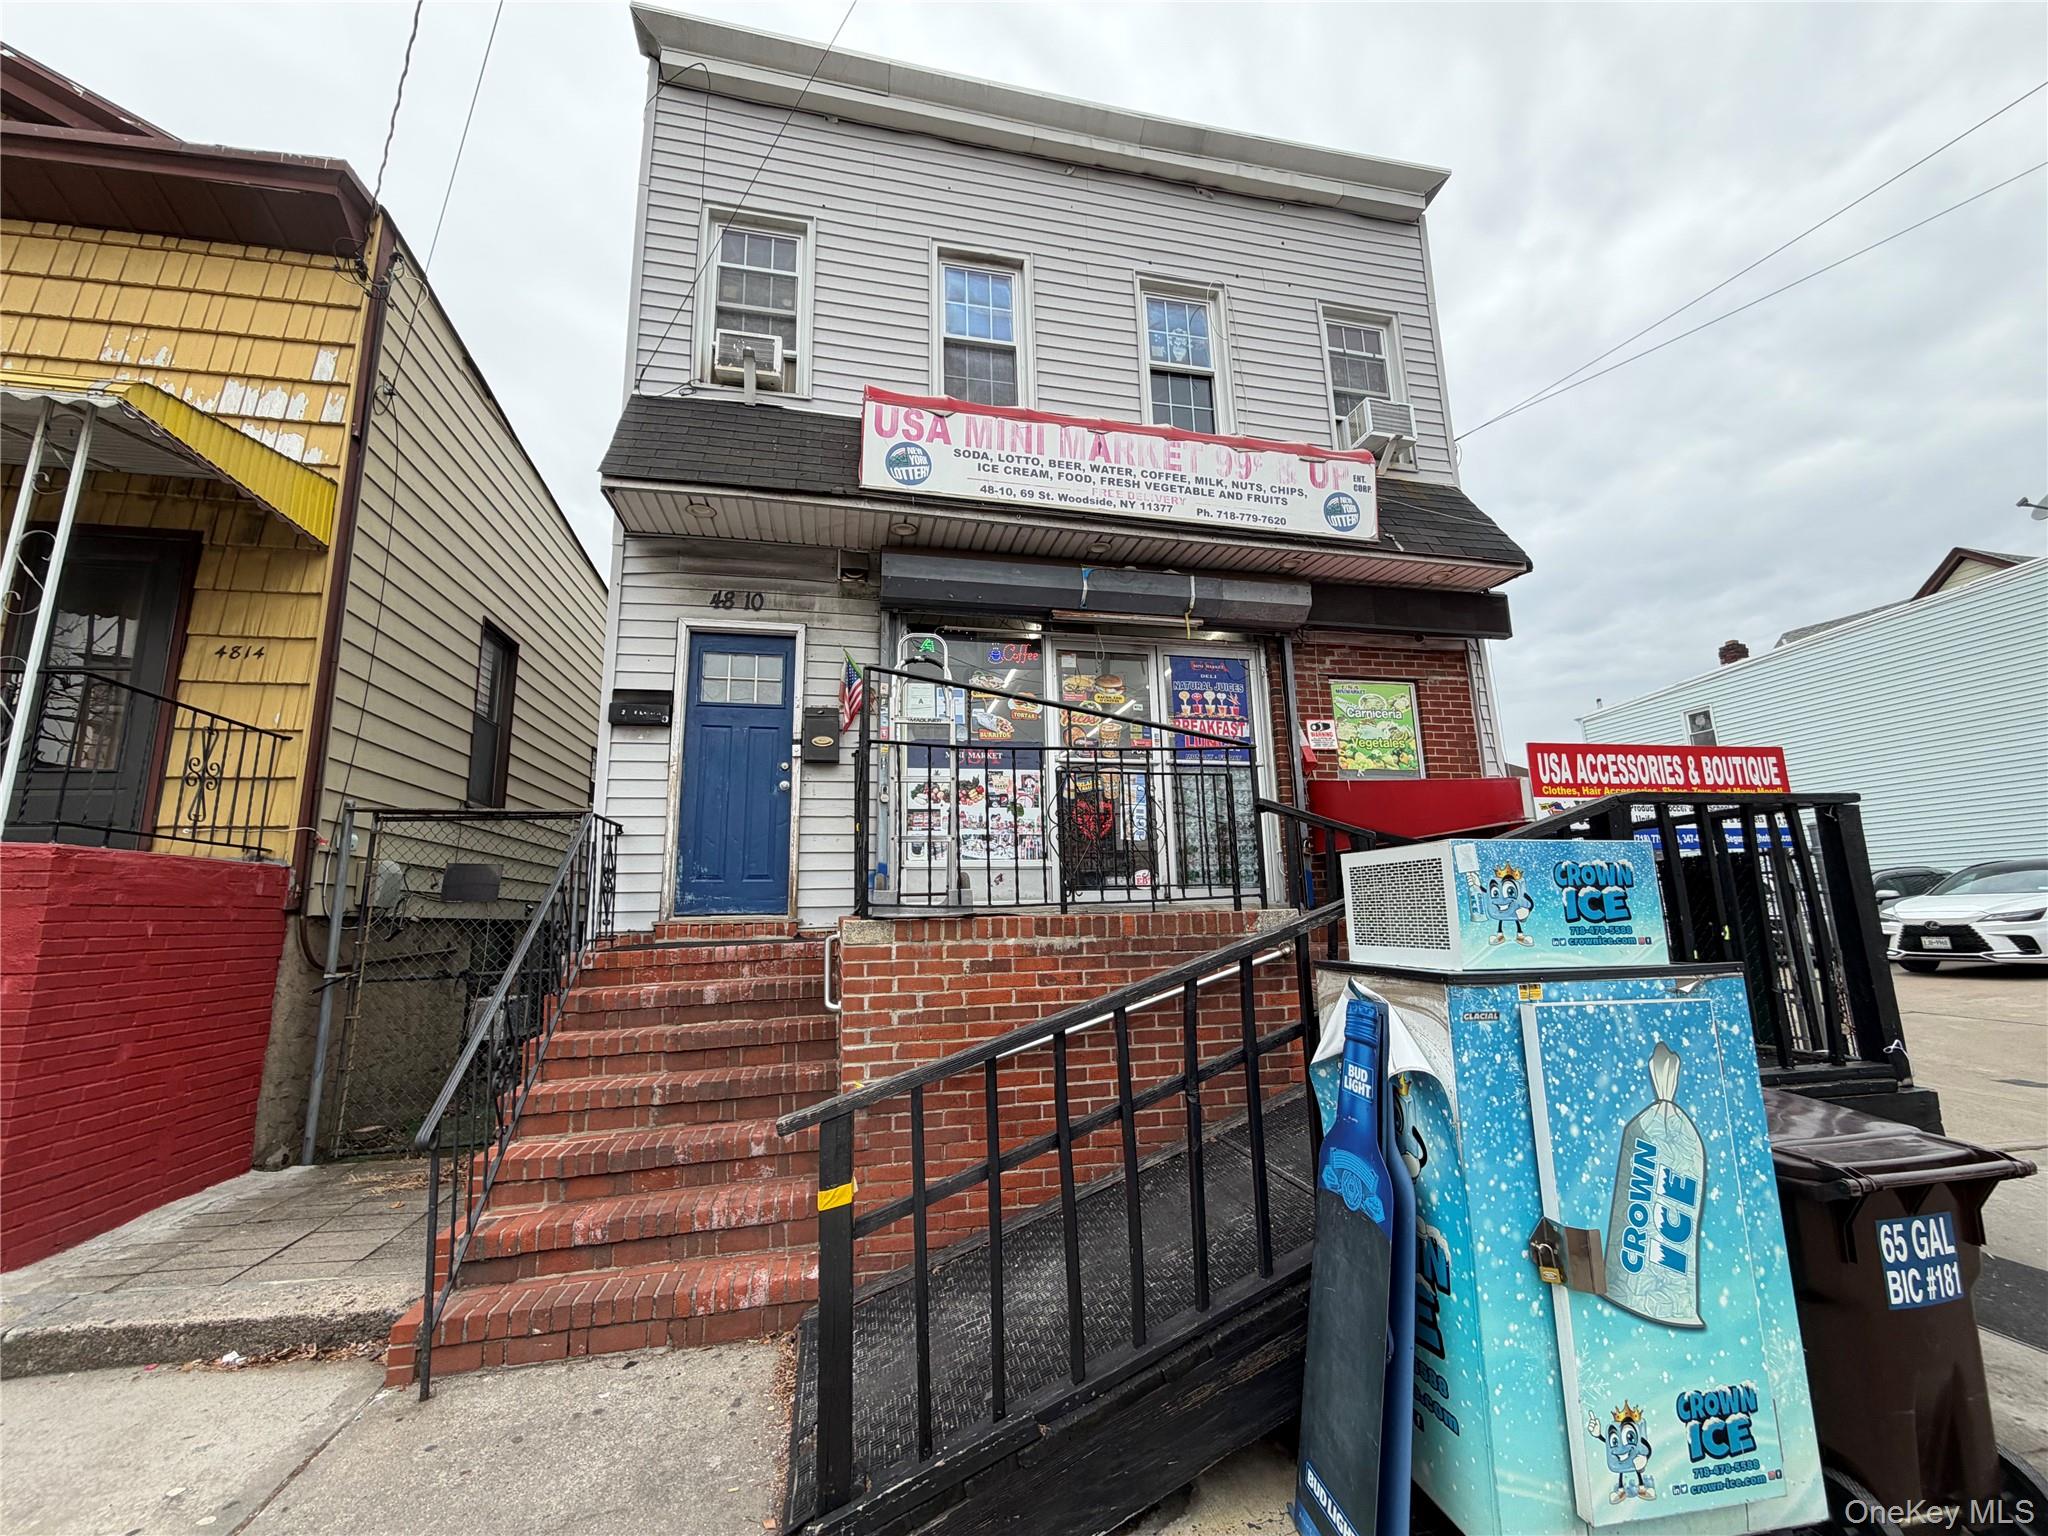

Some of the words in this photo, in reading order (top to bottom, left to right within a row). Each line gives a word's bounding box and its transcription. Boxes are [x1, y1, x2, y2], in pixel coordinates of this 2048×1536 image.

[874, 404, 952, 445] USA
[964, 415, 1045, 456] MINI
[1059, 426, 1203, 473] MARKET
[906, 446, 923, 456] NEW
[909, 455, 928, 466] YORK
[889, 466, 930, 481] LOTTERY
[953, 448, 993, 463] SODA,
[998, 453, 1044, 469] LOTTO,
[1048, 459, 1086, 473] BEER,
[1090, 463, 1137, 478] WATER,
[1140, 469, 1191, 485] COFFEE,
[1194, 475, 1228, 490] MILK,
[1231, 480, 1266, 494] NUTS,
[1270, 485, 1308, 499] CHIPS,
[977, 462, 999, 474] ICE
[1003, 466, 1054, 482] CREAM,
[1058, 471, 1096, 486] FOOD,
[1100, 476, 1140, 489] FRESH
[1144, 481, 1215, 498] VEGETABLE
[1218, 490, 1243, 501] AND
[1246, 493, 1288, 506] FRUITS
[979, 484, 1017, 499] 48-10,
[1020, 488, 1035, 499] 69
[1038, 491, 1054, 501] St.
[1057, 492, 1117, 509] Woodside,
[1120, 499, 1136, 509] NY
[1139, 501, 1173, 513] 11377
[1353, 484, 1373, 494] CORP.
[1196, 507, 1213, 518] Ph.
[1216, 510, 1287, 526] 718-779-7620
[1328, 513, 1360, 528] LOTTERY
[709, 590, 735, 610] 48
[743, 592, 764, 611] 10
[214, 645, 266, 661] 4814
[1002, 643, 1040, 664] Coffee
[1172, 680, 1214, 691] NATURAL
[1214, 682, 1244, 693] JUICES
[979, 731, 1012, 739] BURRITOS
[1173, 719, 1245, 738] BREAKFAST
[1351, 737, 1406, 750] Vegetales
[1537, 752, 1574, 784] USA
[1576, 753, 1685, 785] ACCESSORIES
[1687, 755, 1700, 786] &
[1700, 755, 1781, 787] BOUTIQUE
[1542, 785, 1580, 797] Clothes,
[1581, 786, 1600, 795] Hair
[1553, 860, 1634, 888] CROWN
[1562, 886, 1632, 923] ICE
[1569, 925, 1633, 935] 718-478-5588
[1463, 1012, 1499, 1020] GLACIAL
[1348, 1063, 1368, 1083] BUD
[1344, 1075, 1373, 1099] LIGHT
[1620, 1137, 1657, 1275] CROWN
[1648, 1163, 1698, 1276] ICE
[1879, 1222, 1908, 1264] 65
[1911, 1216, 1956, 1261] GAL
[1886, 1267, 1924, 1305] BIC
[1926, 1261, 1963, 1300] #181
[1676, 1380, 1758, 1424] CROWN
[1686, 1412, 1757, 1463] ICE
[1692, 1458, 1760, 1480] 718-478-5588
[1690, 1474, 1767, 1496] crown-ice.com
[1307, 1468, 1327, 1507] BUD
[1327, 1497, 1356, 1536] LIGH
